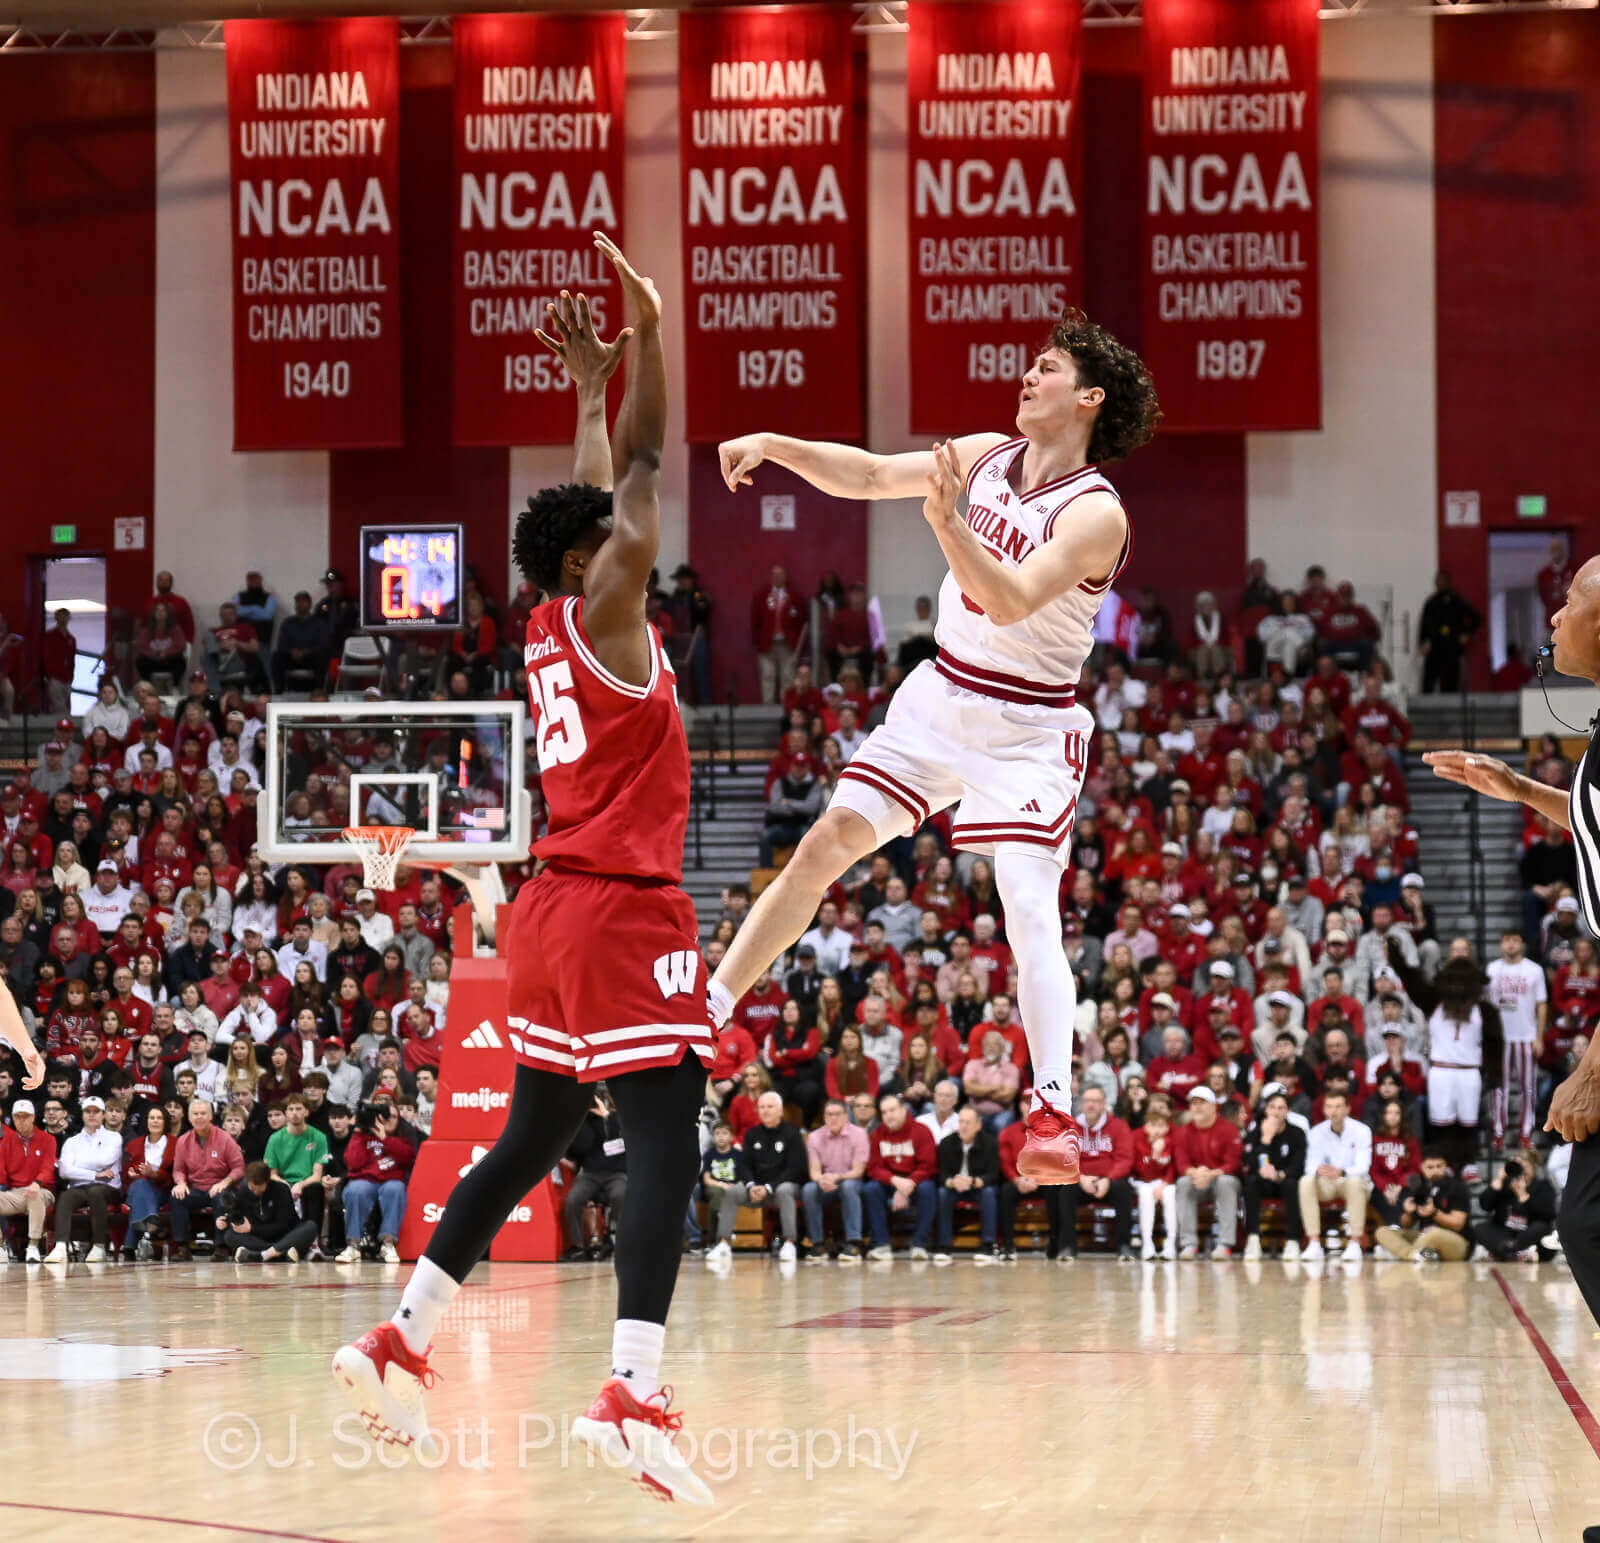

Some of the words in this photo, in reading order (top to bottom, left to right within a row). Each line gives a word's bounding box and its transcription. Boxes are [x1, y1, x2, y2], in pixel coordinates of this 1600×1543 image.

[483, 66, 595, 106] INDIANA
[711, 60, 825, 101] INDIANA
[938, 52, 1054, 92] INDIANA
[1171, 45, 1289, 86] INDIANA
[256, 71, 369, 111] INDIANA
[465, 112, 611, 152] UNIVERSITY
[692, 105, 843, 148] UNIVERSITY
[919, 99, 1072, 139] UNIVERSITY
[1152, 91, 1307, 135] UNIVERSITY
[240, 118, 386, 159] UNIVERSITY
[460, 171, 617, 230] NCAA
[688, 164, 848, 226] NCAA
[915, 157, 1076, 217] NCAA
[1148, 151, 1312, 215] NCAA
[239, 177, 391, 237] NCAA
[464, 249, 612, 288] BASKETBALL
[692, 243, 842, 284] BASKETBALL
[919, 236, 1072, 276] BASKETBALL
[1152, 231, 1307, 275] BASKETBALL
[242, 255, 387, 295] BASKETBALL
[698, 290, 837, 331] CHAMPIONS
[925, 283, 1065, 323] CHAMPIONS
[1159, 278, 1302, 321] CHAMPIONS
[248, 301, 382, 342] CHAMPIONS
[284, 360, 350, 399] 1940
[504, 354, 571, 392] 1953
[738, 348, 804, 389] 1976
[969, 342, 1027, 382] 1981
[1197, 339, 1267, 380] 1987
[124, 527, 135, 545] 5
[653, 950, 698, 1000] W
[451, 1087, 509, 1112] meijer
